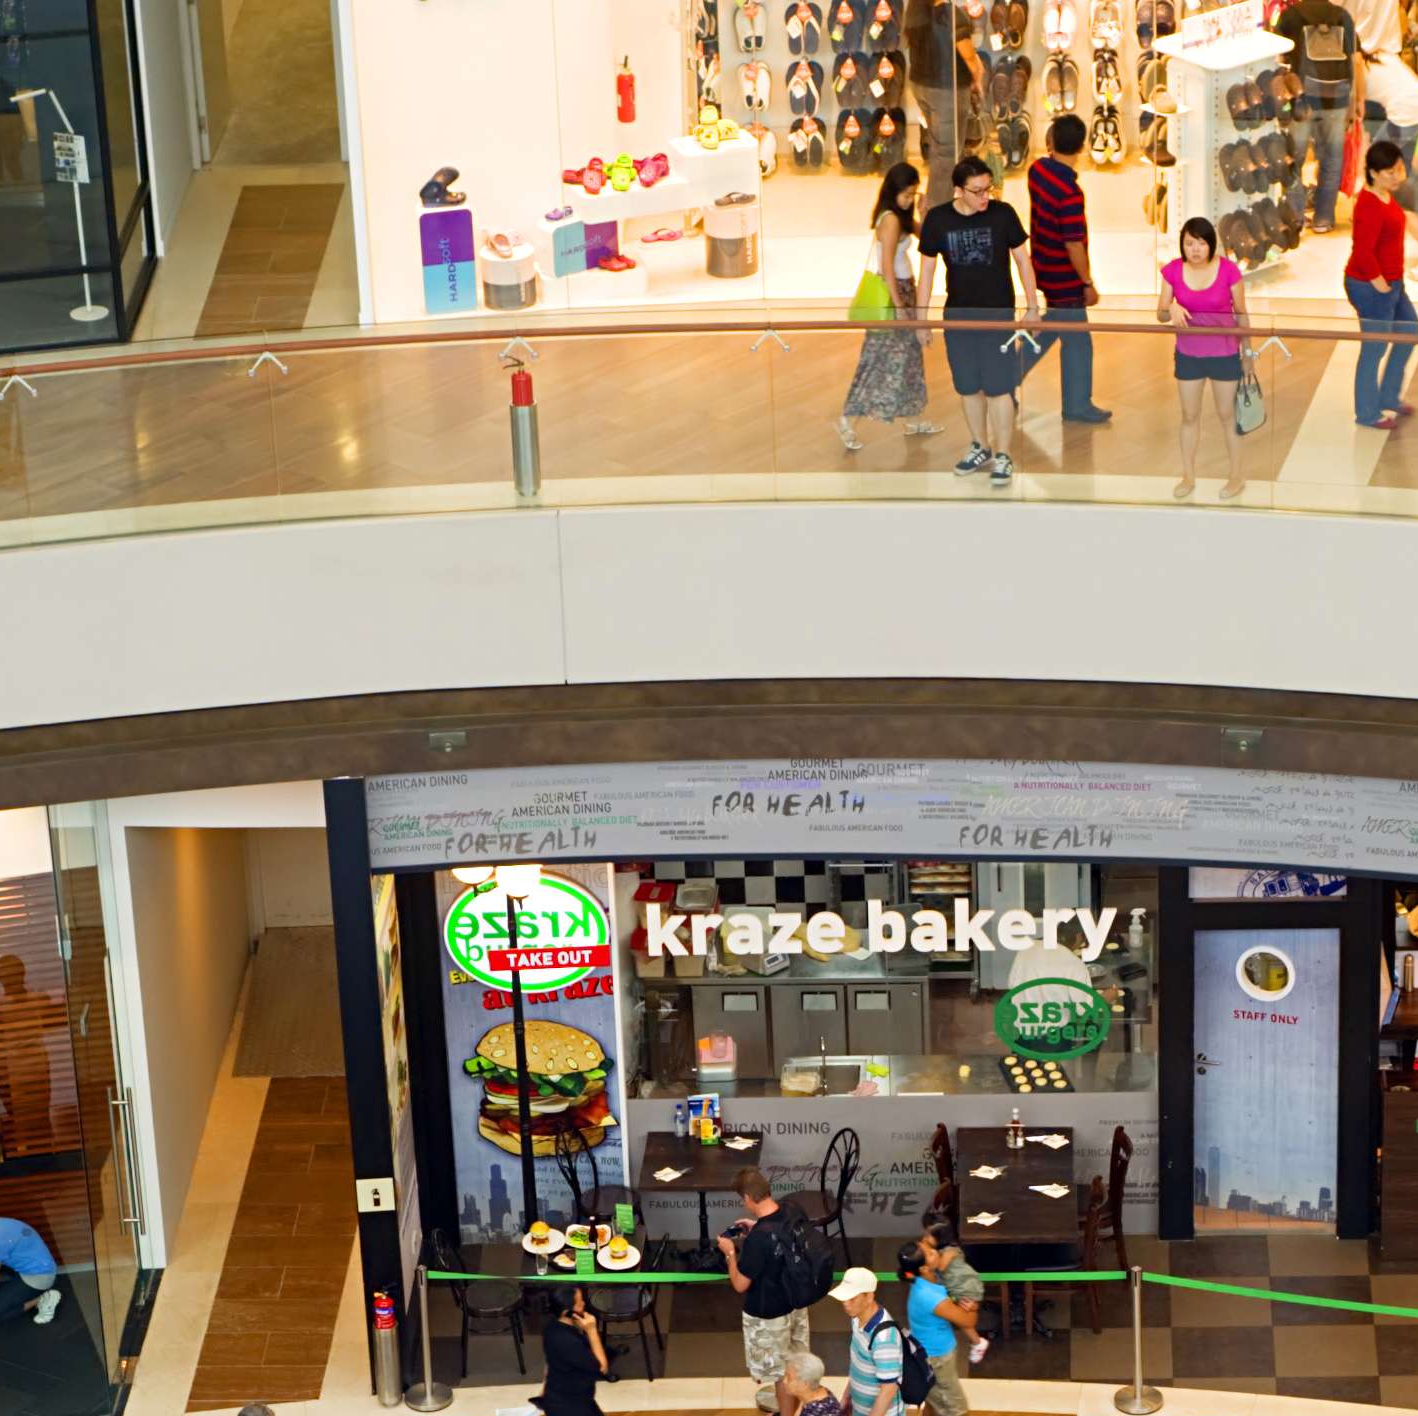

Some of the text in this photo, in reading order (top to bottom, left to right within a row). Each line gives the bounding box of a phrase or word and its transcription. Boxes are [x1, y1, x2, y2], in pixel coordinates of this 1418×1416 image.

[791, 757, 843, 769] GOURMET
[768, 769, 826, 781] AMERICAN
[367, 774, 469, 793] AMERICAN DINING
[1021, 782, 1085, 791] NUTRITIONALLY
[1088, 783, 1131, 792] BALANCED
[1133, 784, 1152, 792] DIET
[534, 791, 588, 805] GOURMET
[712, 790, 865, 817] FOR HEALTH
[511, 802, 613, 818] AMERICAN DINING
[620, 815, 639, 825] DIET
[809, 824, 904, 833] FABULOUS AMERICAN FOOD
[959, 824, 1113, 850] FOR HEALTH
[422, 842, 443, 851] FOOD
[445, 832, 490, 860] FOR
[1366, 847, 1405, 858] FABULOUS
[645, 897, 1118, 962] kraze bakery
[506, 953, 554, 968] TAKE
[557, 949, 593, 965] OUT
[1233, 1008, 1300, 1026] STAFF ONLY
[723, 1121, 831, 1135] RICAN DINING
[706, 1200, 745, 1209] AMERIC
